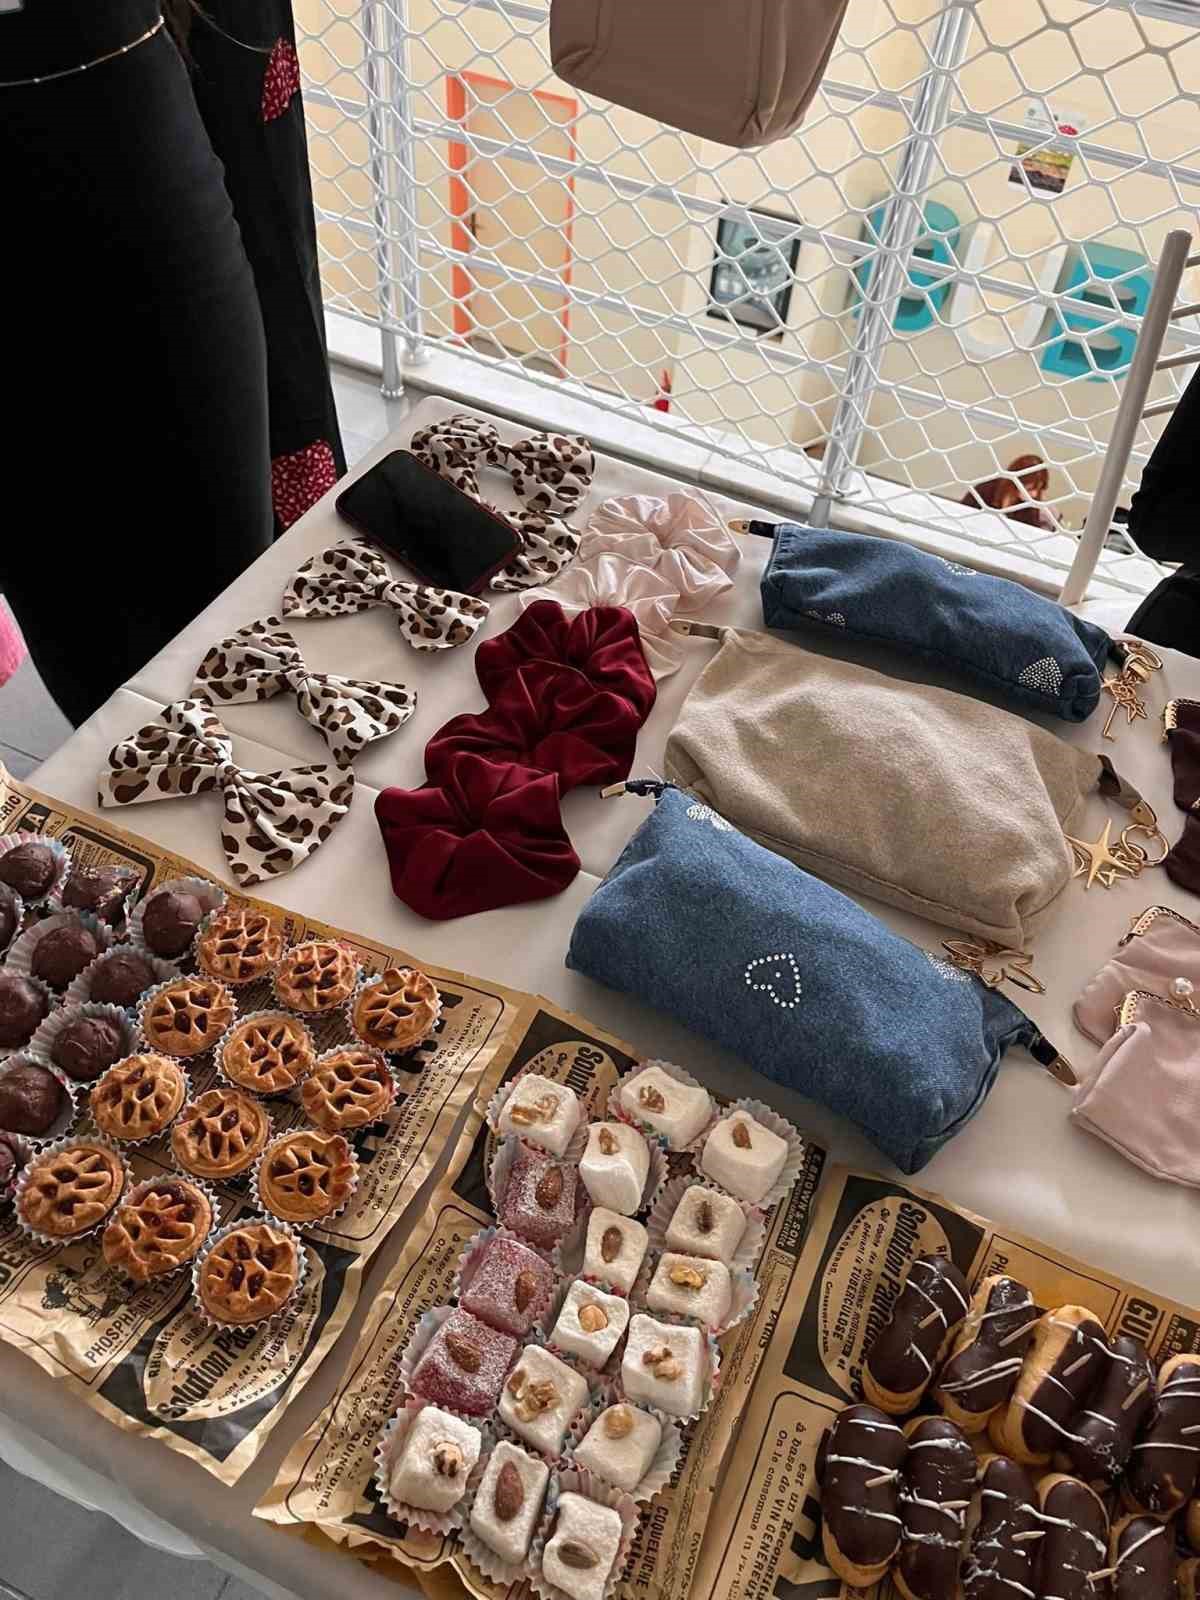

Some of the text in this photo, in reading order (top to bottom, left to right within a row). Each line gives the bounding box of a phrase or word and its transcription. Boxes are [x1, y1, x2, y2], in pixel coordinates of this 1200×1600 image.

[785, 1221, 800, 1247] SON
[884, 1203, 925, 1276] Solution
[832, 1267, 861, 1340] TUBERCULOSE
[775, 1429, 788, 1447] On
[771, 1450, 782, 1463] le
[784, 1437, 802, 1471] base
[777, 1475, 790, 1493] de
[794, 1462, 807, 1486] est
[750, 1466, 774, 1530] consomme
[769, 1498, 785, 1521] VIN
[786, 1491, 798, 1512] un
[635, 1506, 668, 1587] COQUELUCHE
